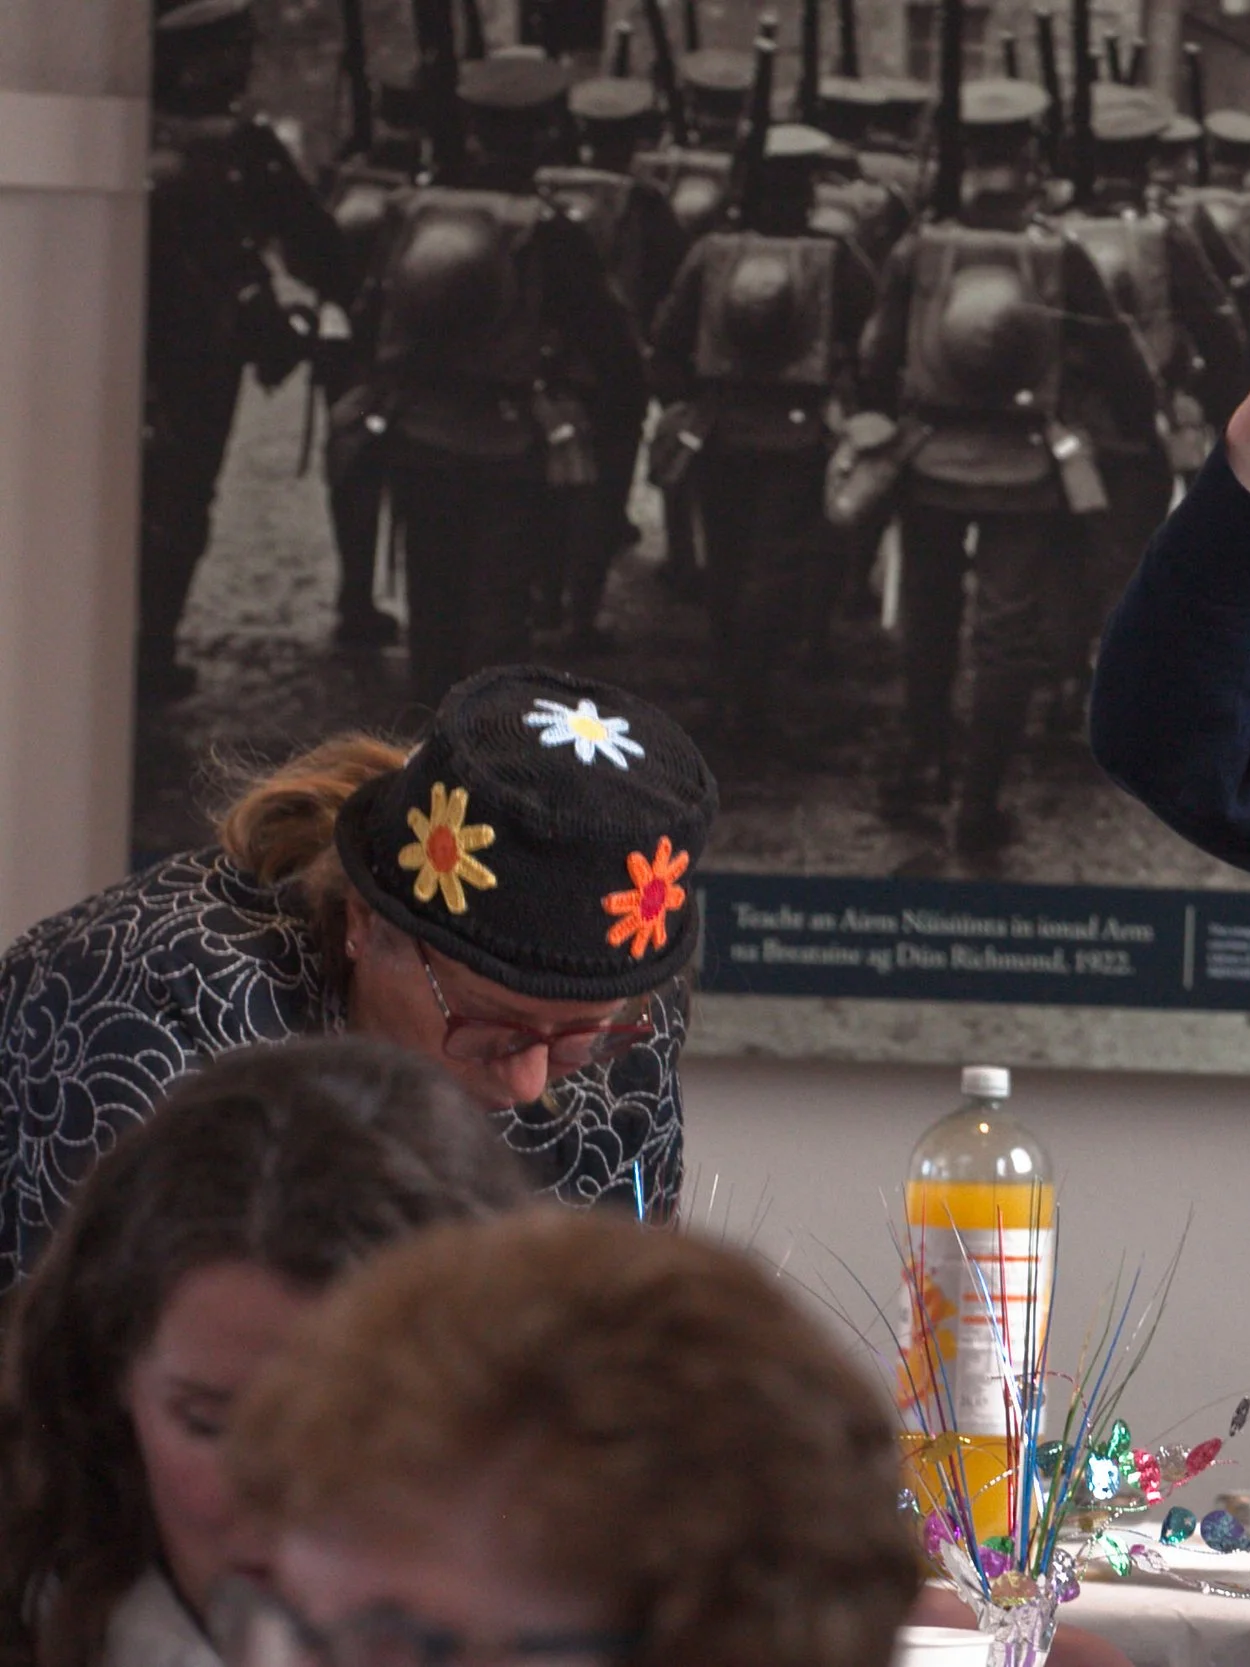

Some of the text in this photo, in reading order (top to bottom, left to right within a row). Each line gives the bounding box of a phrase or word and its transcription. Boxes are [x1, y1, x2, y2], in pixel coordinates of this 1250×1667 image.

[731, 901, 1155, 943] Teacht an Airm Náisiúnta in ionad Arm
[730, 937, 1137, 976] na Breataine ag Dún Richmond, 1922.
